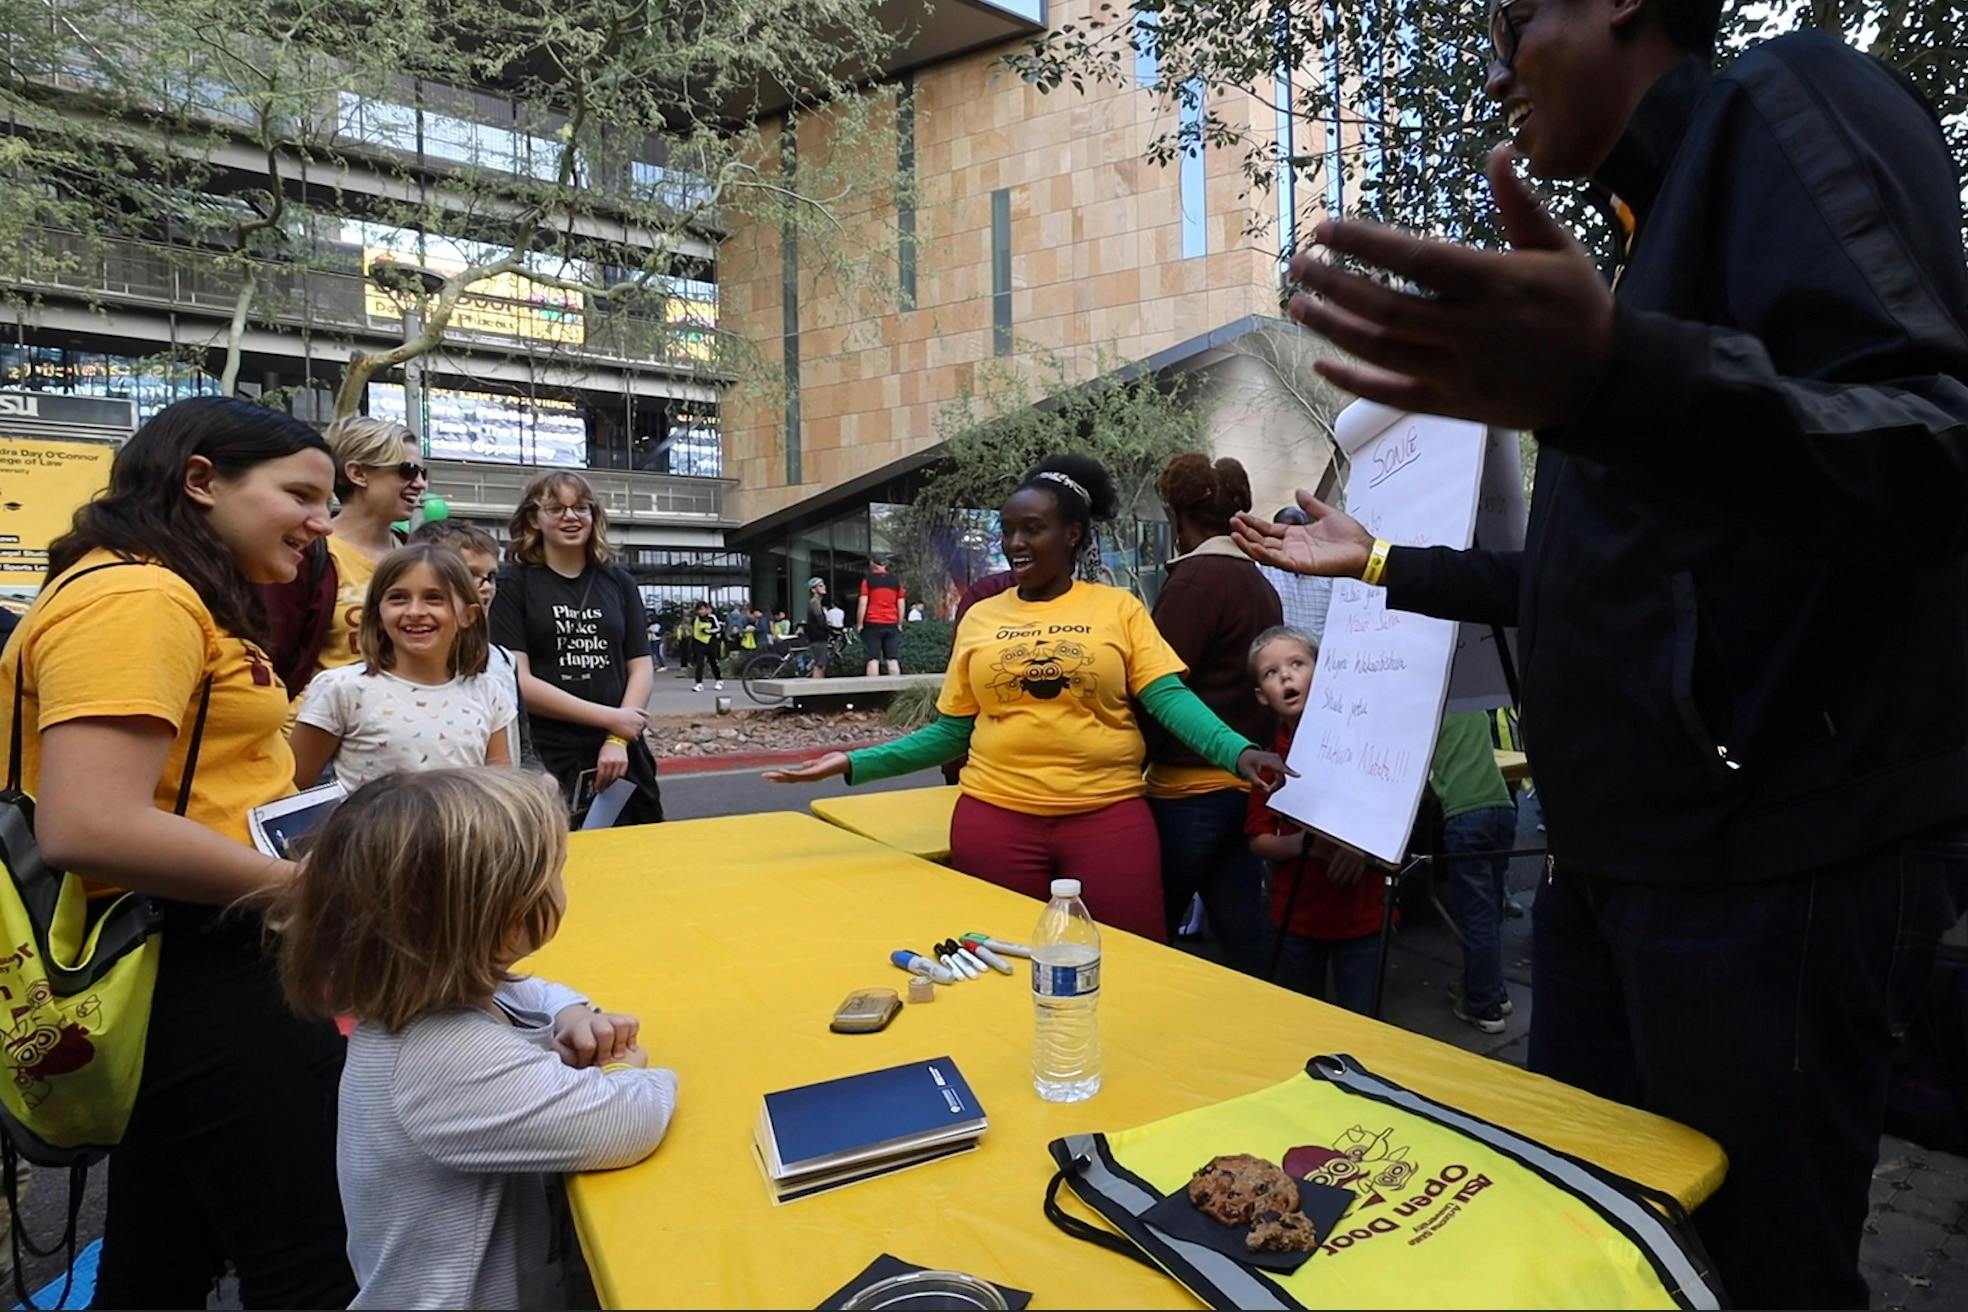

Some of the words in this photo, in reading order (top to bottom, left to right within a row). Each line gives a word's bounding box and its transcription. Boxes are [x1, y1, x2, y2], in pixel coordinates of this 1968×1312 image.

[0, 394, 39, 417] SU
[0, 447, 18, 456] dra
[20, 449, 43, 459] Day
[45, 450, 100, 462] O'Connor
[24, 457, 37, 466] of
[39, 457, 64, 468] Law
[552, 605, 603, 620] Plants
[996, 629, 1042, 641] Open
[1048, 625, 1092, 635] Door
[557, 635, 609, 653] People
[1393, 1164, 1469, 1217] Open
[1320, 1217, 1401, 1257] Door
